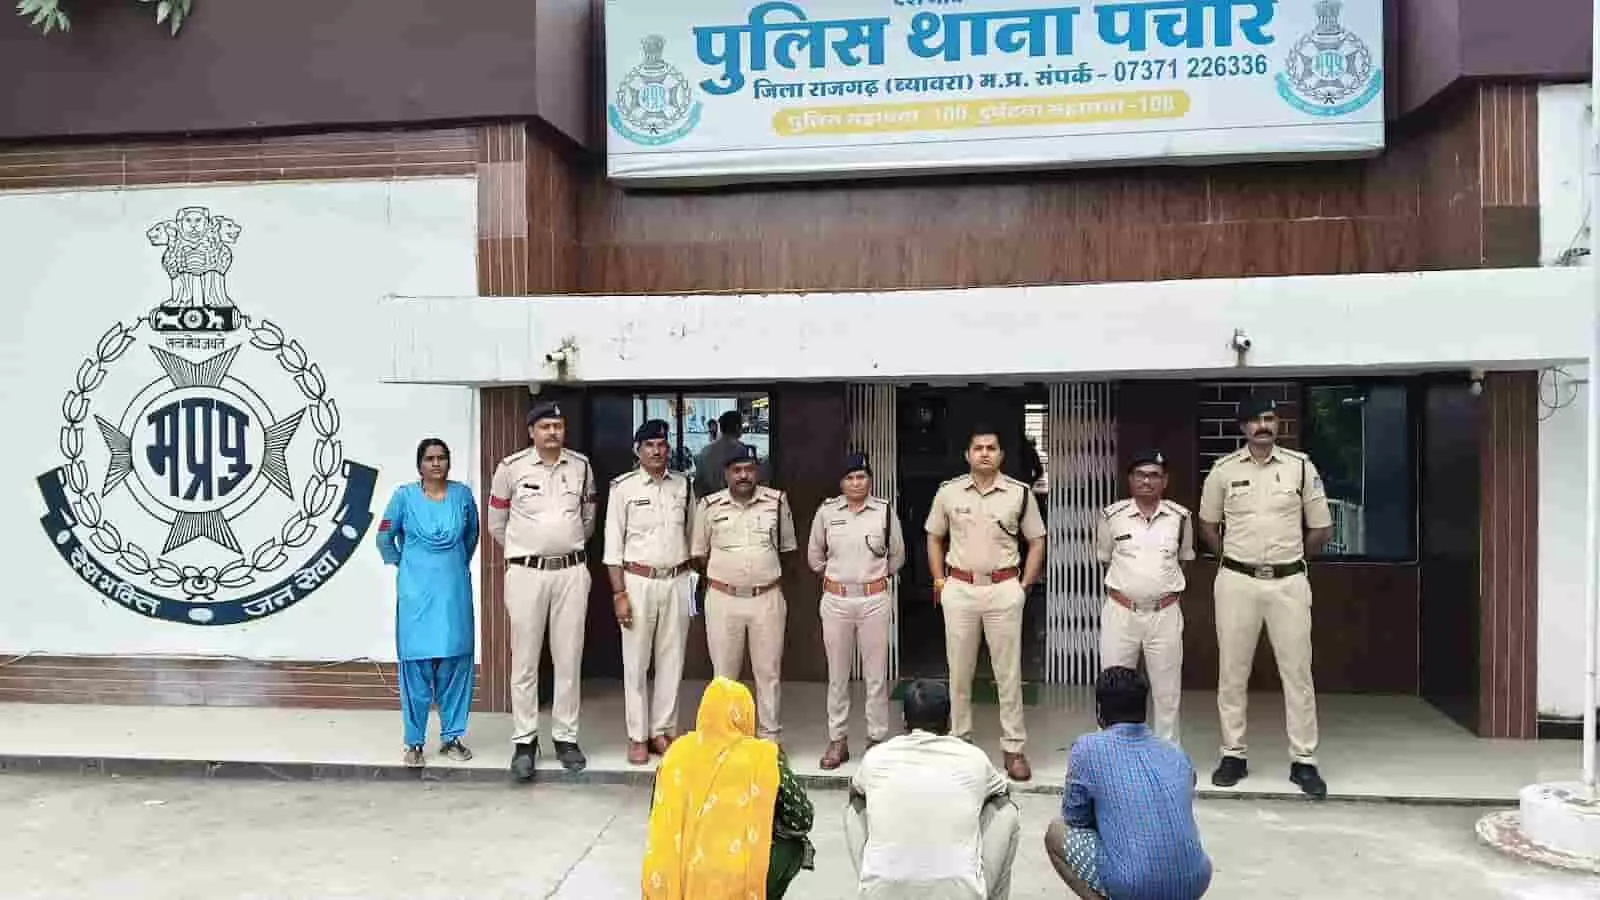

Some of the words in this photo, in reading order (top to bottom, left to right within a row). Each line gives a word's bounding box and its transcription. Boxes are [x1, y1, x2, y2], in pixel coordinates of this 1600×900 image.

[692, 1, 890, 95] पुलिस
[906, 7, 1081, 62] थाना
[753, 78, 803, 99] जिला
[1113, 58, 1178, 82] 07371
[1186, 54, 1268, 78] 226336
